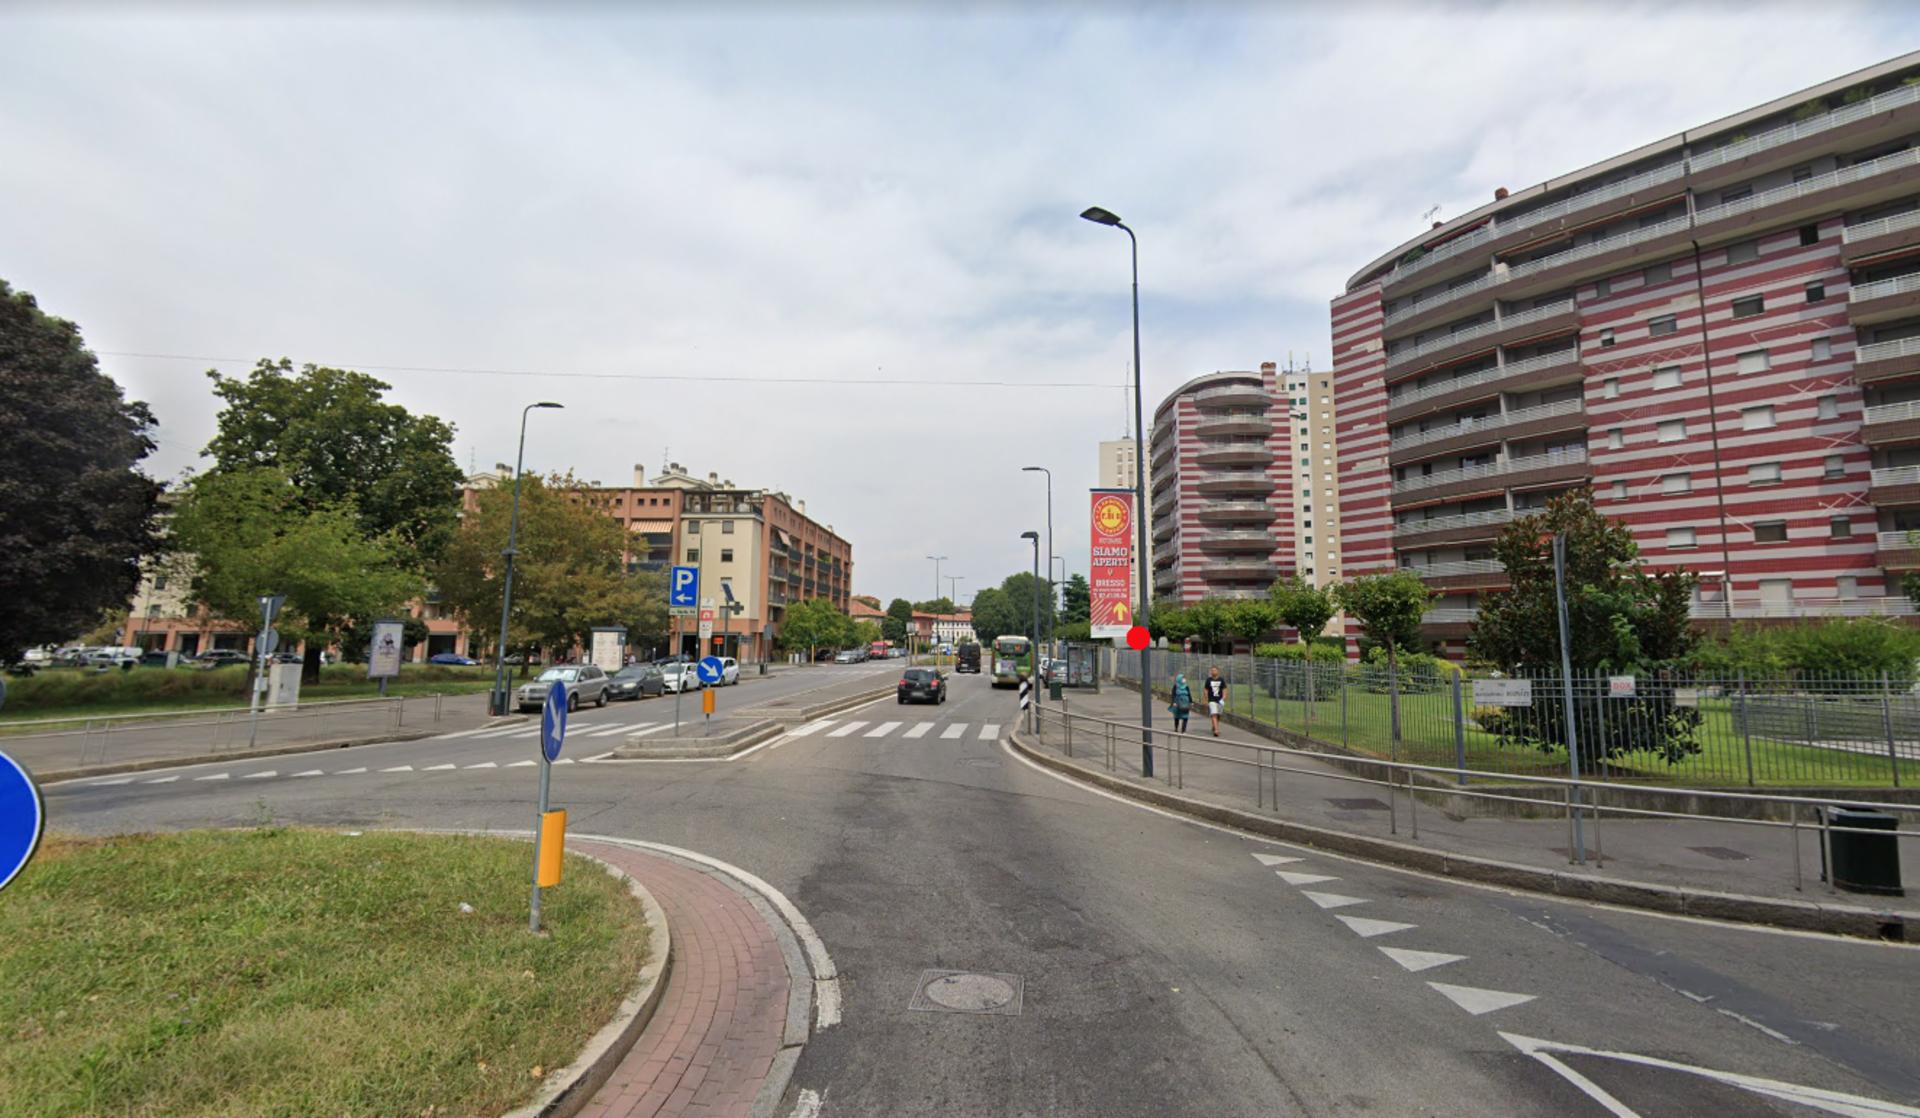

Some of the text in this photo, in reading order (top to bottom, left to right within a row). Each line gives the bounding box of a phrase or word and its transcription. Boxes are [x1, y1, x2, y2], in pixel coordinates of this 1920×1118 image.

[1093, 547, 1128, 556] SIAMO
[1093, 558, 1129, 567] APERTI
[676, 570, 694, 591] P
[1095, 579, 1125, 587] BRESSO
